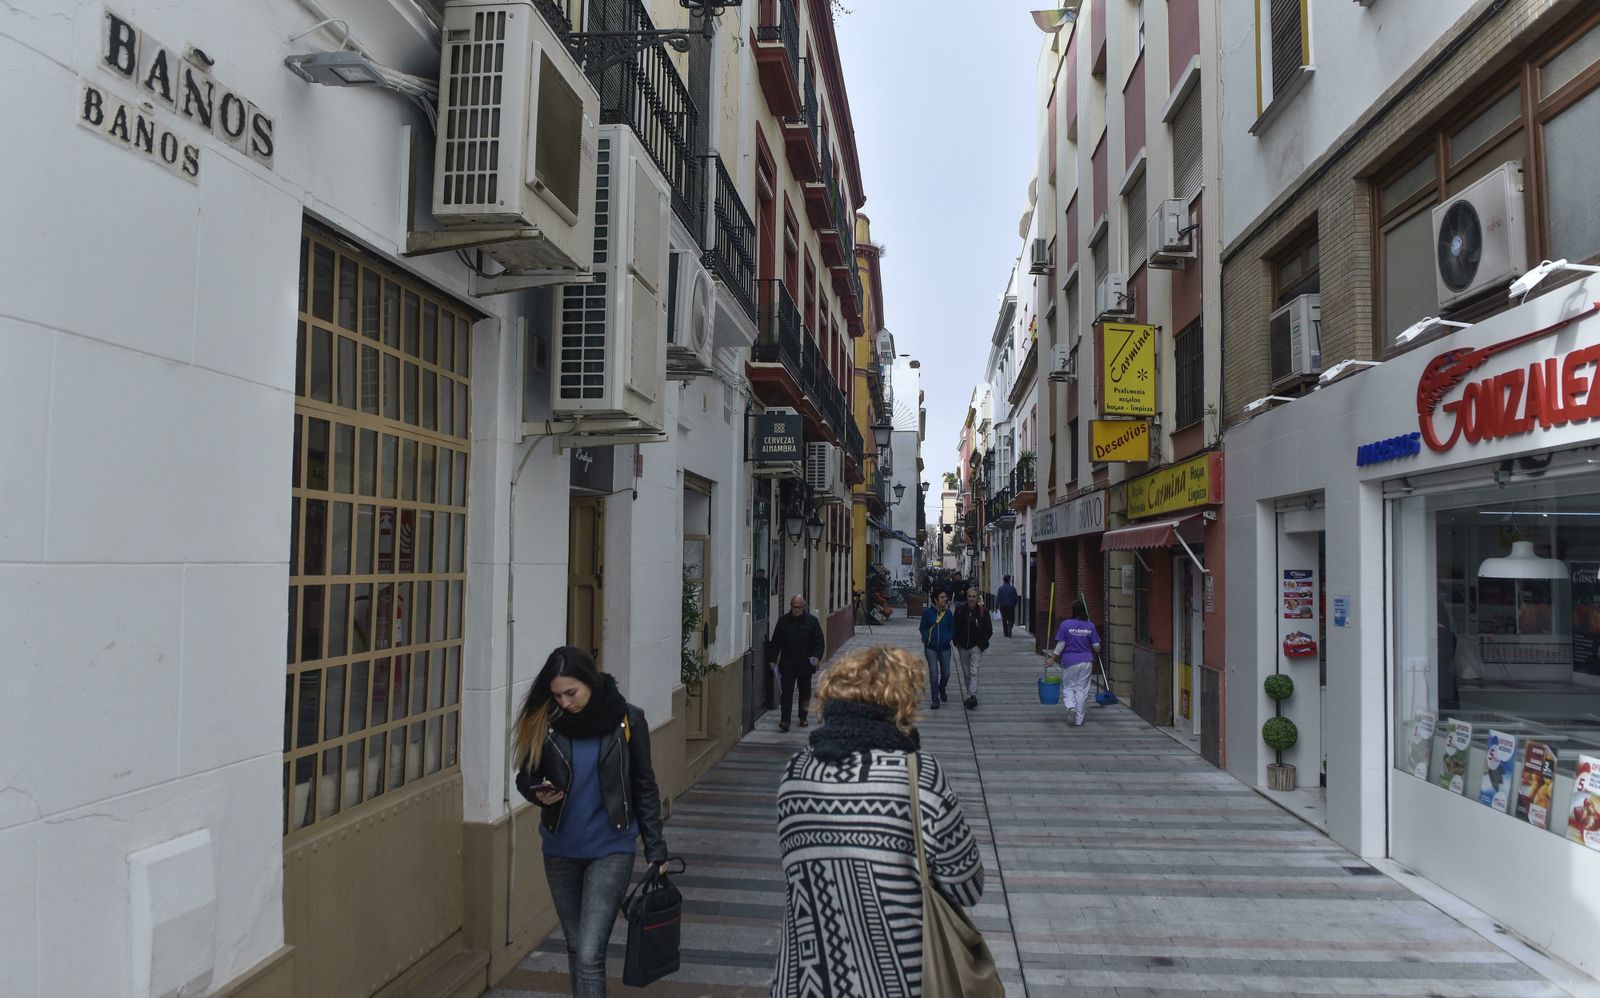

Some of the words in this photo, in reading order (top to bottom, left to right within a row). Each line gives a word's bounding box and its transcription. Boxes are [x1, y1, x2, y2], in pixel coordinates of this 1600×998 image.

[105, 13, 273, 157] BAÑOS
[82, 86, 199, 177] BAÑOS
[1110, 328, 1151, 383] Carmina
[764, 436, 795, 444] CERVEZAS
[1095, 423, 1147, 459] Desavios
[1148, 470, 1186, 509] Carmina
